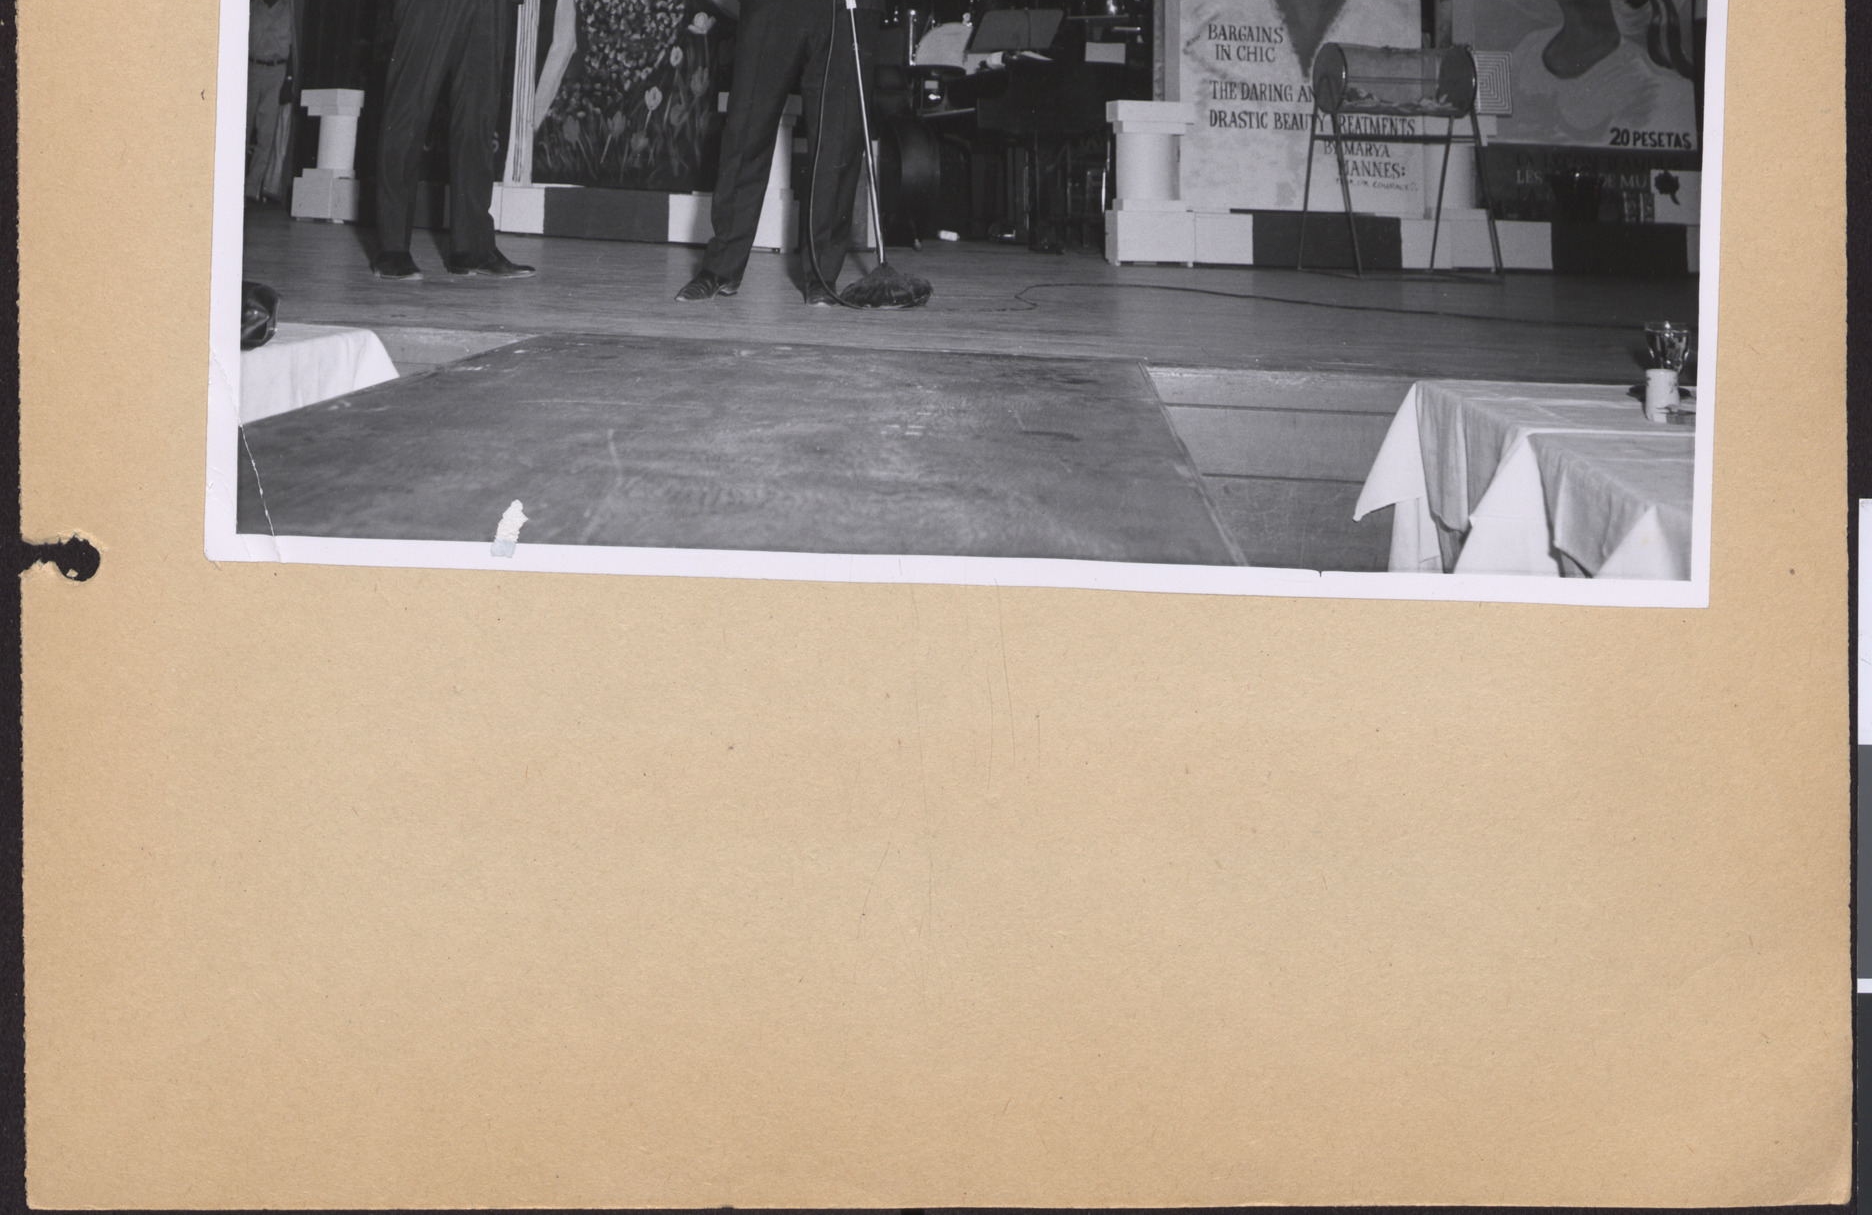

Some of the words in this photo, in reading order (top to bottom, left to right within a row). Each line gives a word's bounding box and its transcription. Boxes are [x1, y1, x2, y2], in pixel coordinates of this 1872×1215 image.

[1208, 23, 1284, 44] BARGAINS
[1215, 44, 1232, 61] IN
[1236, 45, 1276, 63] CHIC
[1209, 80, 1238, 100] THE
[1240, 82, 1294, 103] DARING
[1296, 85, 1316, 103] AN
[1209, 109, 1269, 130] DRASTIC
[1336, 114, 1416, 136] REATMENTS
[1343, 141, 1391, 158] MARYA
[1609, 127, 1630, 146] 20
[1632, 130, 1692, 150] PESETAS
